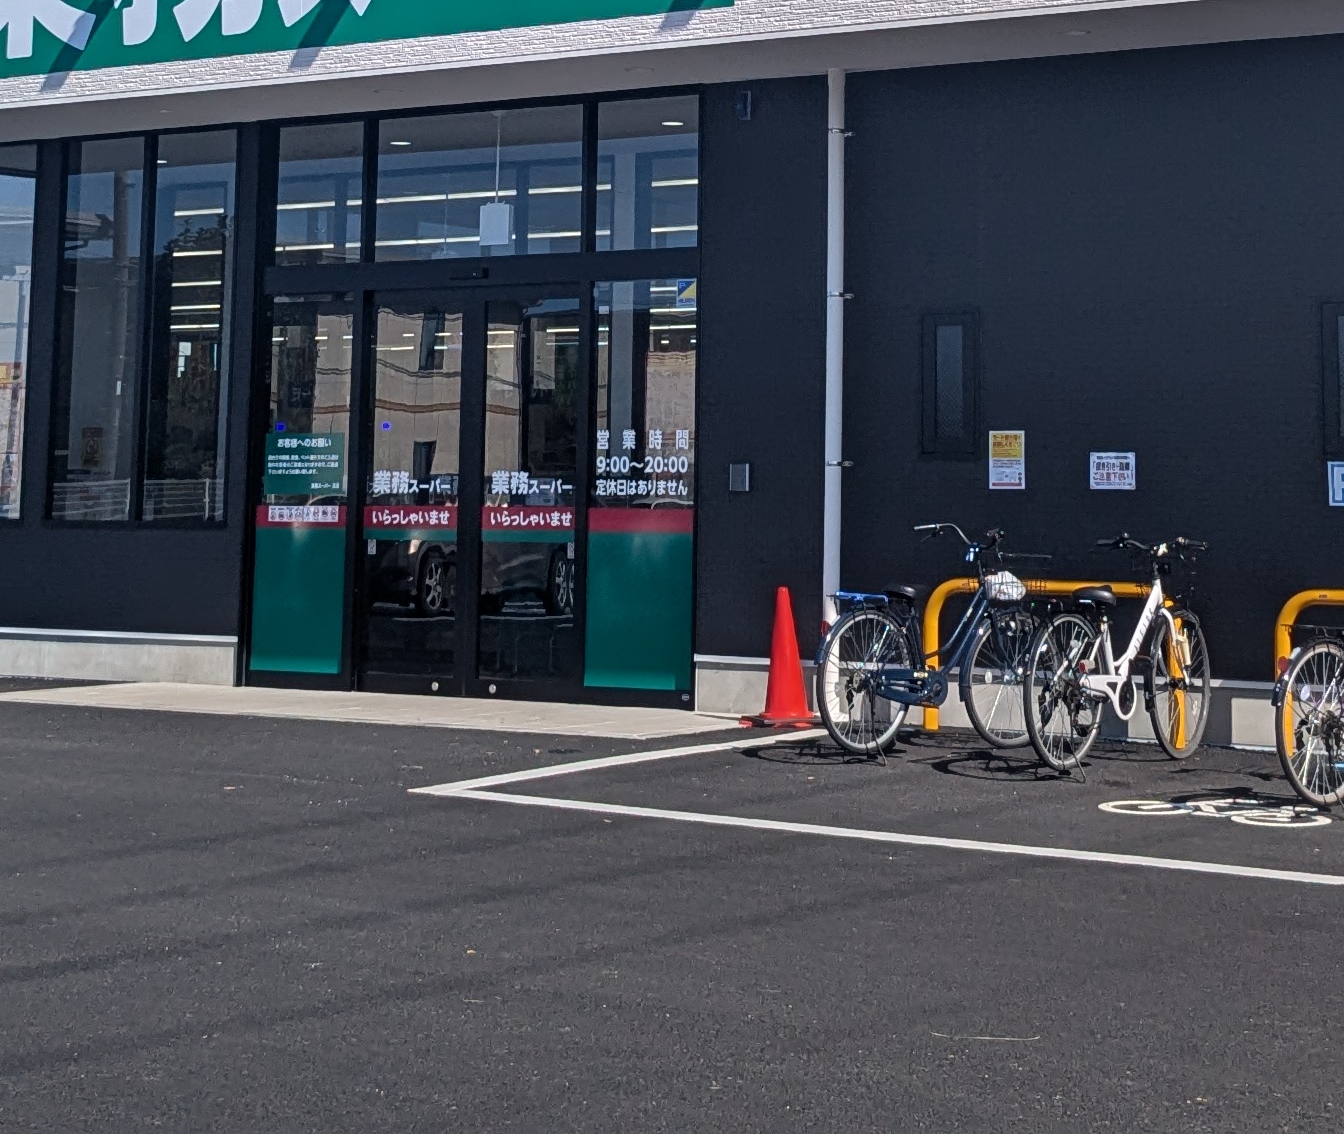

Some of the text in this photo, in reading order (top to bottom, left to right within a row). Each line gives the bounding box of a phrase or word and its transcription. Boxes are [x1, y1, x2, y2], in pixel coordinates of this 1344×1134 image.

[596, 429, 689, 450] 営業時間
[373, 469, 451, 494] 業務スーパー
[492, 470, 573, 495] 業務スーパー
[596, 479, 688, 496] 定休日はありません
[372, 509, 450, 525] いらっしゃいませ
[490, 511, 572, 527] いらっしゃいませ
